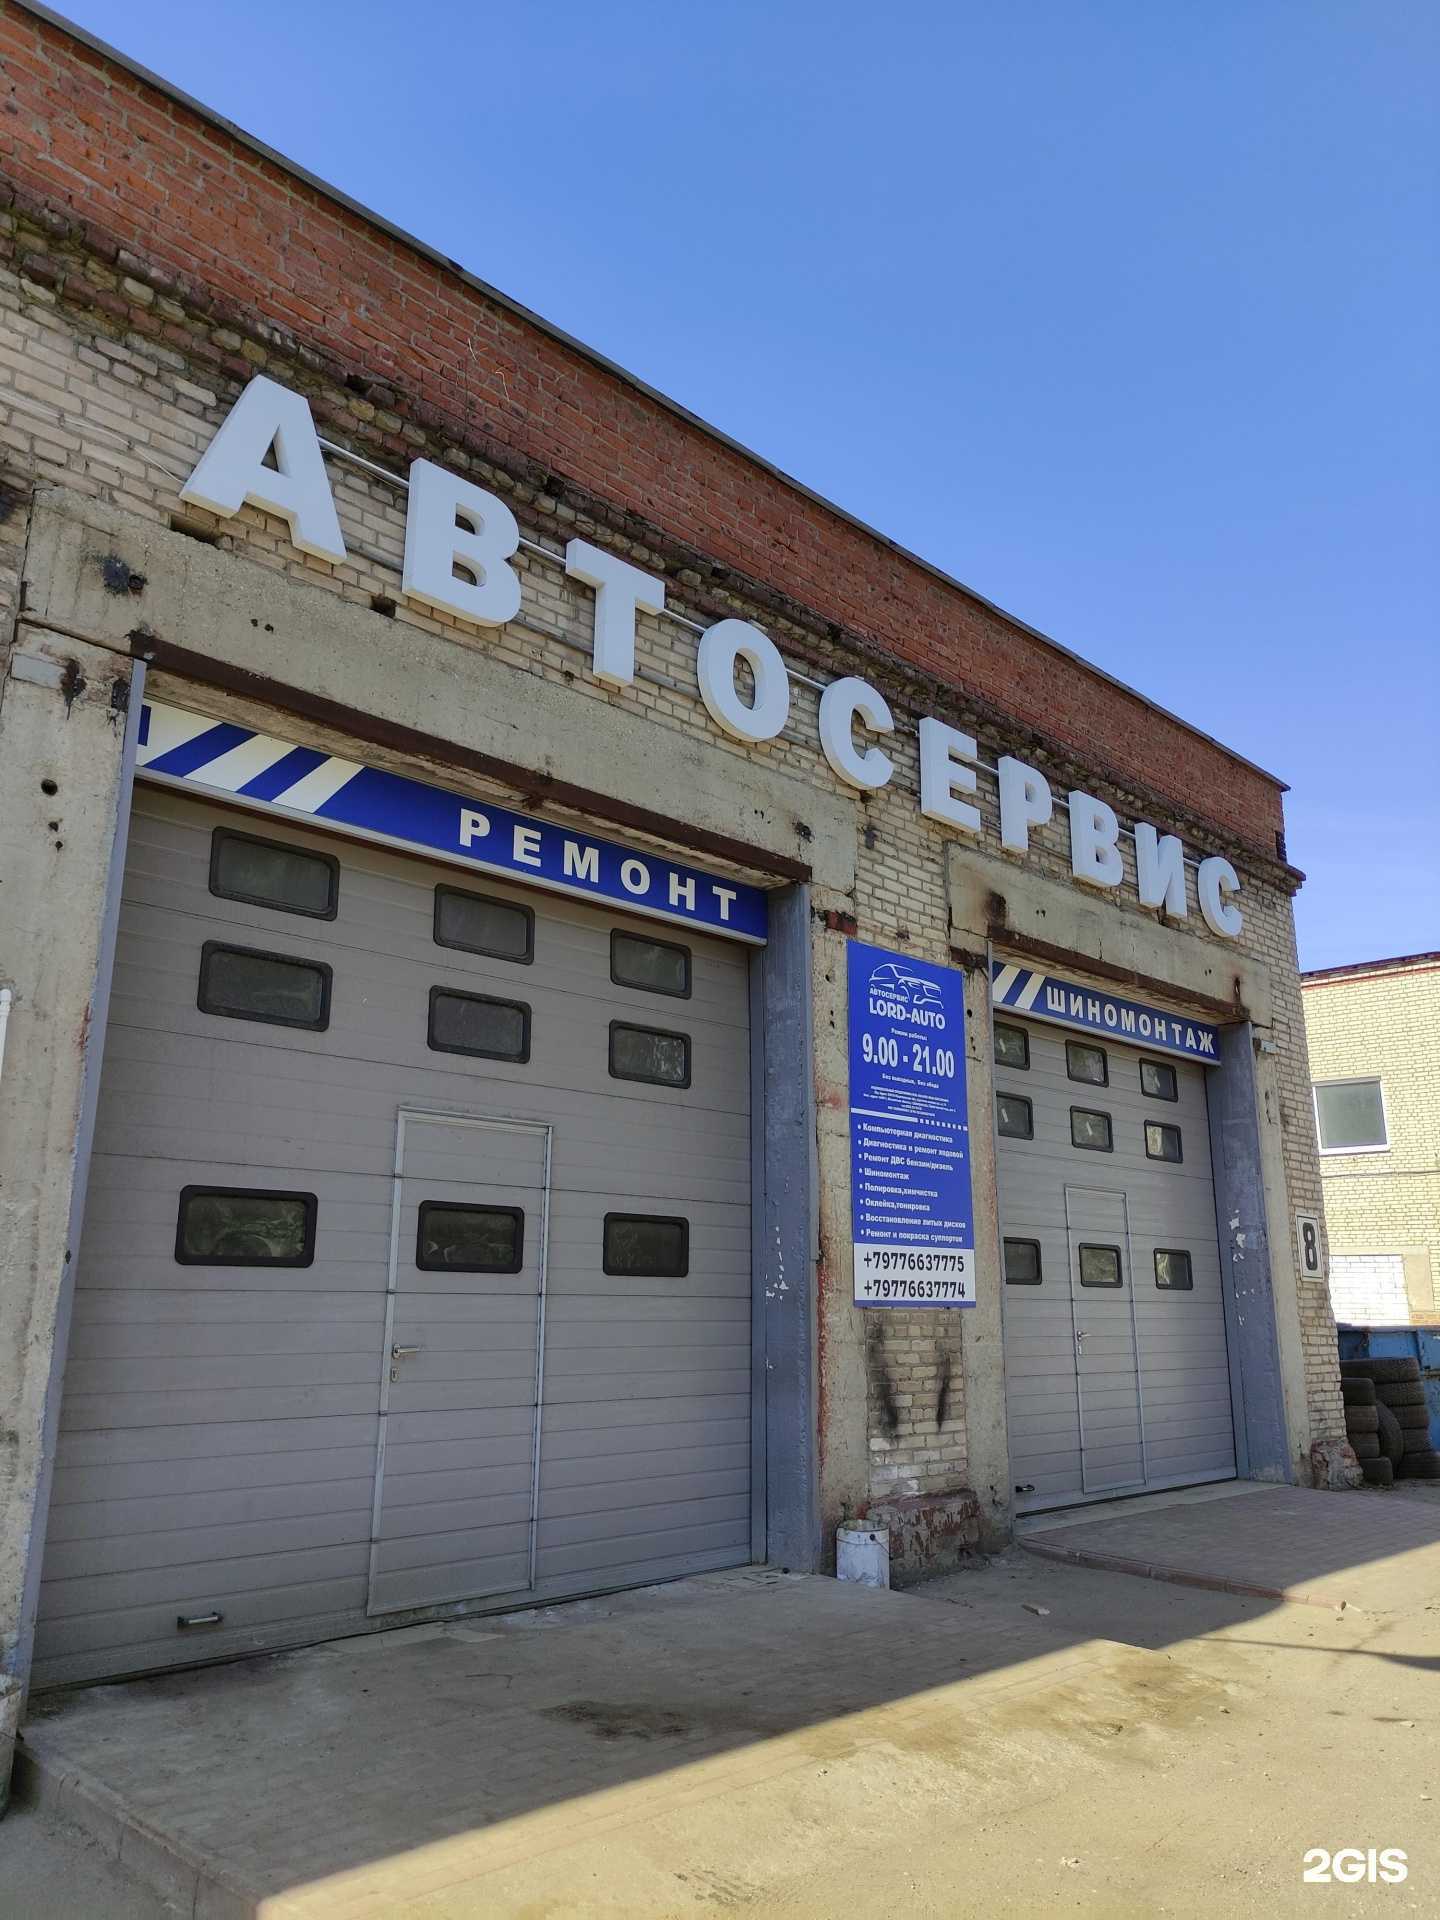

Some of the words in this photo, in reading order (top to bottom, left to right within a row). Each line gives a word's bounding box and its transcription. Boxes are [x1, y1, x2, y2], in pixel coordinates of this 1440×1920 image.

[179, 374, 1243, 938] АВТОСЕРВИС
[458, 807, 738, 922] РЕМОНТ
[869, 987, 909, 1004] АВТОСЕРВИС
[869, 997, 946, 1030] LORD-AUTO
[1046, 985, 1215, 1054] ШИНОМОНТАЖ
[862, 1033, 898, 1068] 9.00
[912, 1043, 955, 1078] 21.00
[863, 1122, 913, 1138] Компьютерная
[913, 1131, 953, 1144] диагностика
[863, 1137, 907, 1151] Диагностика
[914, 1146, 937, 1156] ремонт
[863, 1152, 890, 1163] Ремонт
[890, 1155, 905, 1166] ДВС
[864, 1167, 910, 1181] Шиномонтаж
[865, 1213, 922, 1225] Восстановление
[866, 1228, 892, 1238] Ремонт
[1302, 1221, 1318, 1271] 8
[863, 1251, 965, 1272] +79776637775
[863, 1279, 966, 1298] +79776637774
